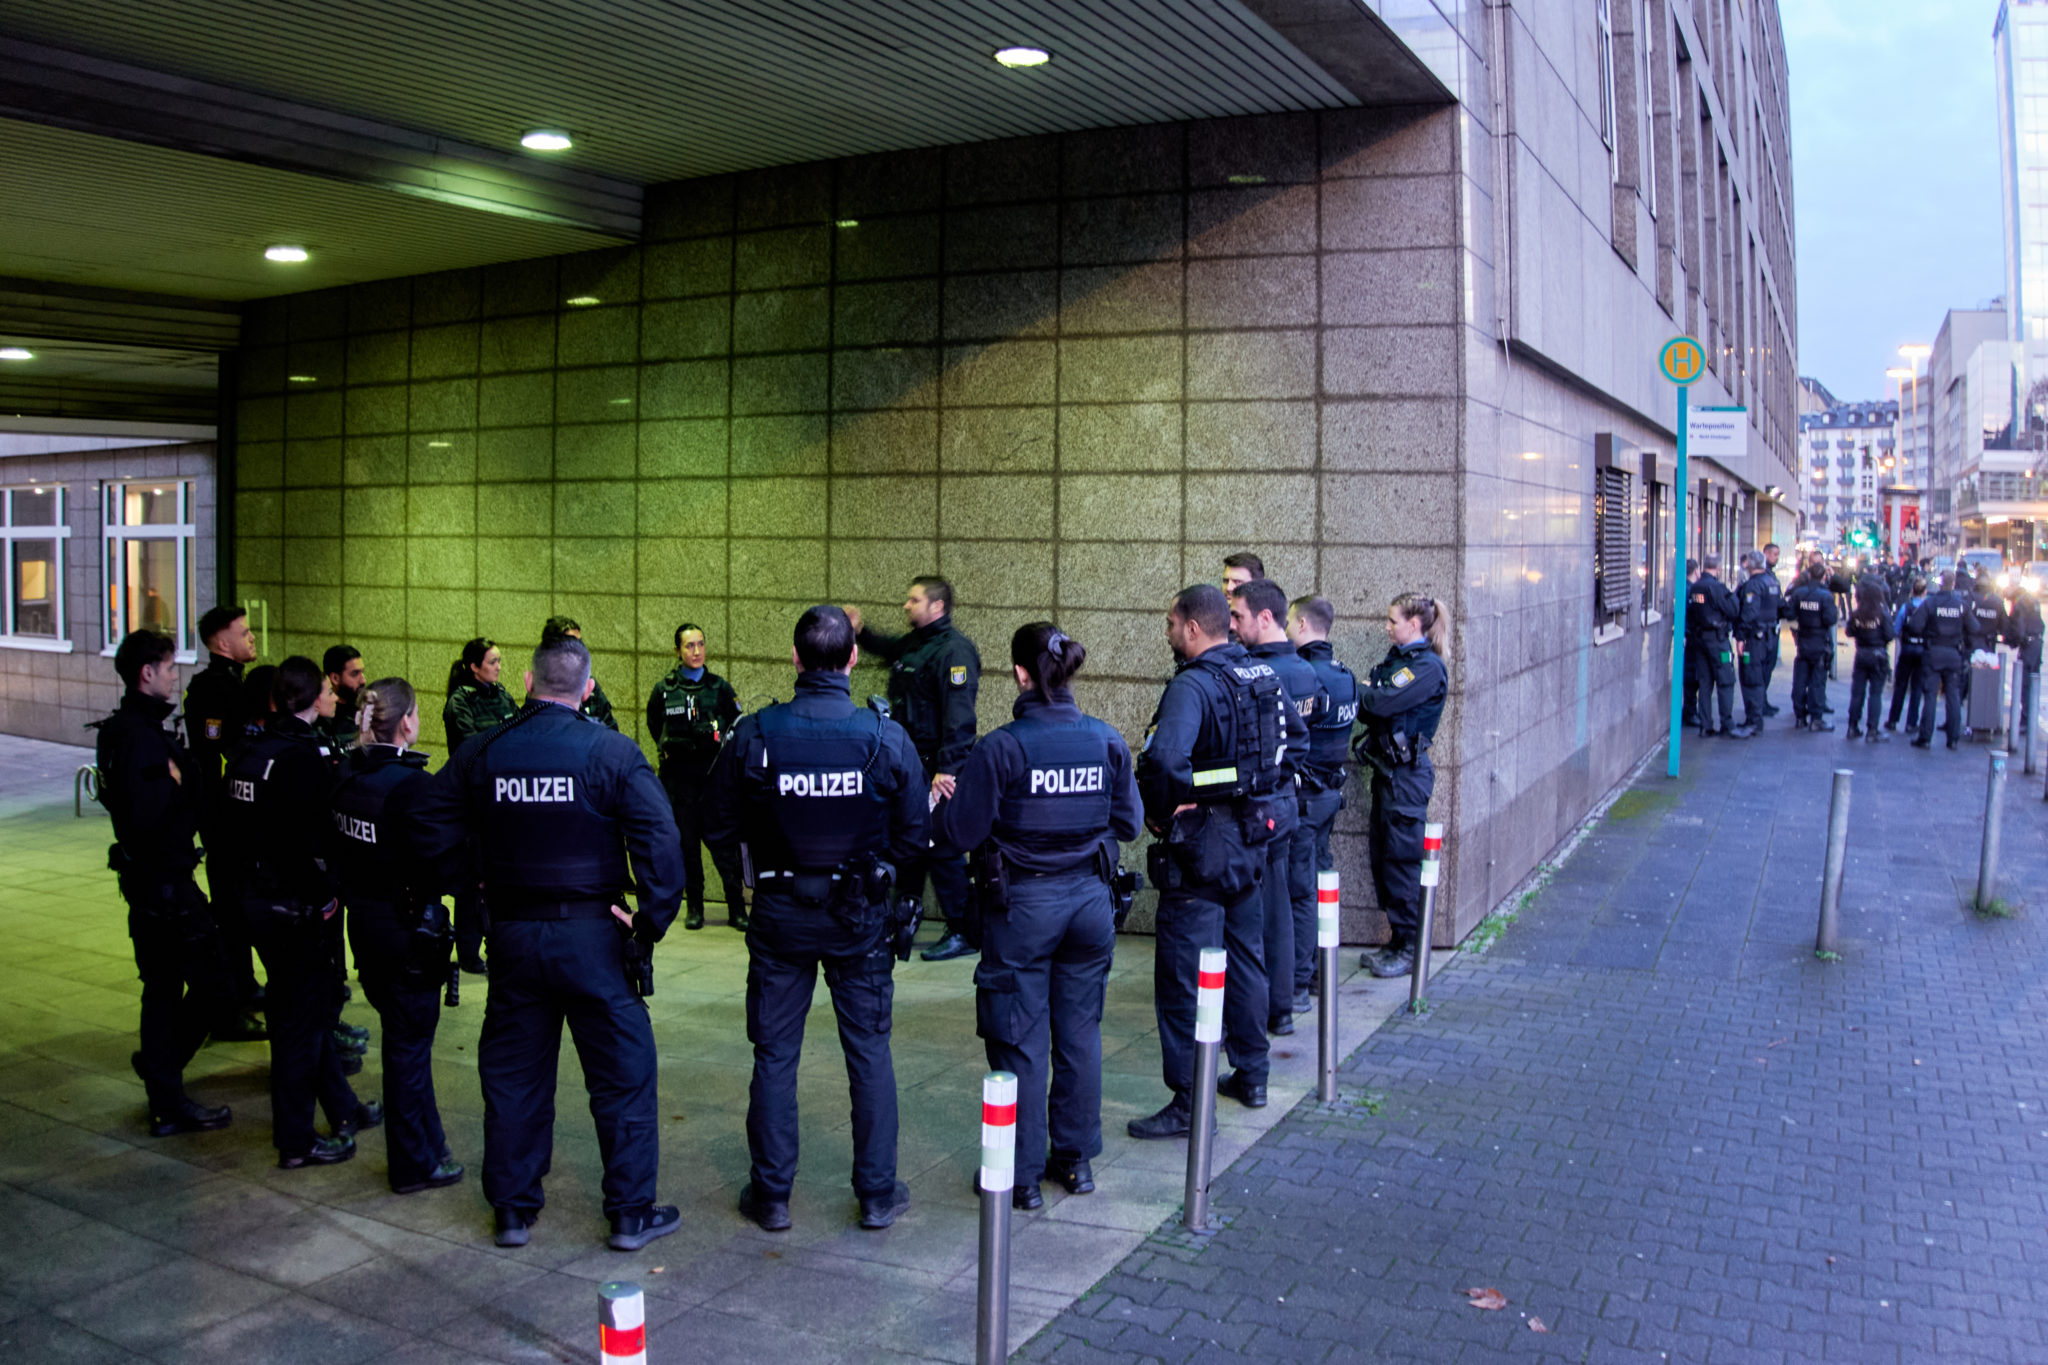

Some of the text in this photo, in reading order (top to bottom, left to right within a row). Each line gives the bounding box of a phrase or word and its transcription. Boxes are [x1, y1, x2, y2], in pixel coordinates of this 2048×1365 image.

[1673, 347, 1692, 374] H
[1689, 422, 1735, 431] Warteposition
[1799, 600, 1820, 611] POLIZEI
[1936, 606, 1959, 618] POLIZEI
[1976, 608, 1998, 619] POLIZEI
[666, 706, 685, 716] POLIZEI
[1337, 701, 1359, 722] POLI
[231, 779, 254, 802] LIZEI
[495, 776, 575, 802] POLIZEI
[778, 771, 863, 797] POLIZEI
[1031, 766, 1103, 794] POLIZEI
